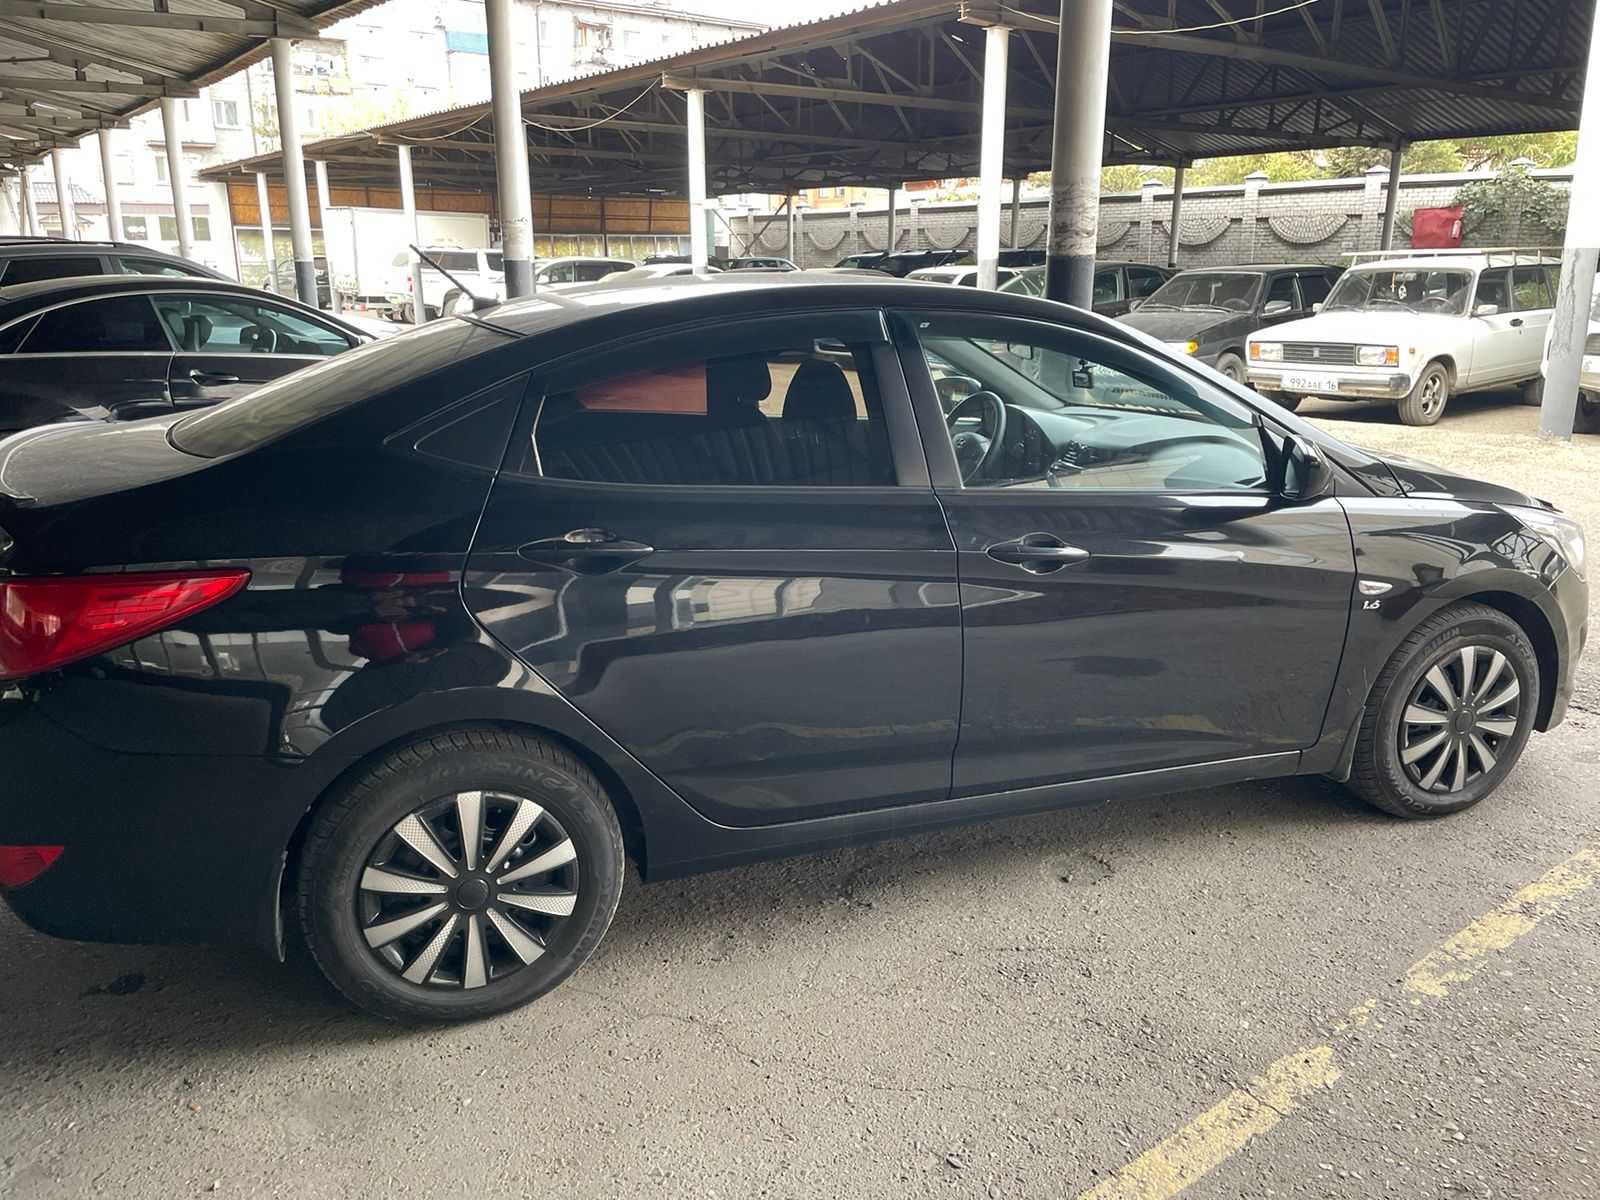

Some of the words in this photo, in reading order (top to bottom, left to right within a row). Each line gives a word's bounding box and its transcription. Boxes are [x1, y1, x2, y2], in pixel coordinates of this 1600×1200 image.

[1290, 378, 1306, 388] 992
[1327, 380, 1337, 390] 16
[1362, 600, 1380, 610] 1.6
